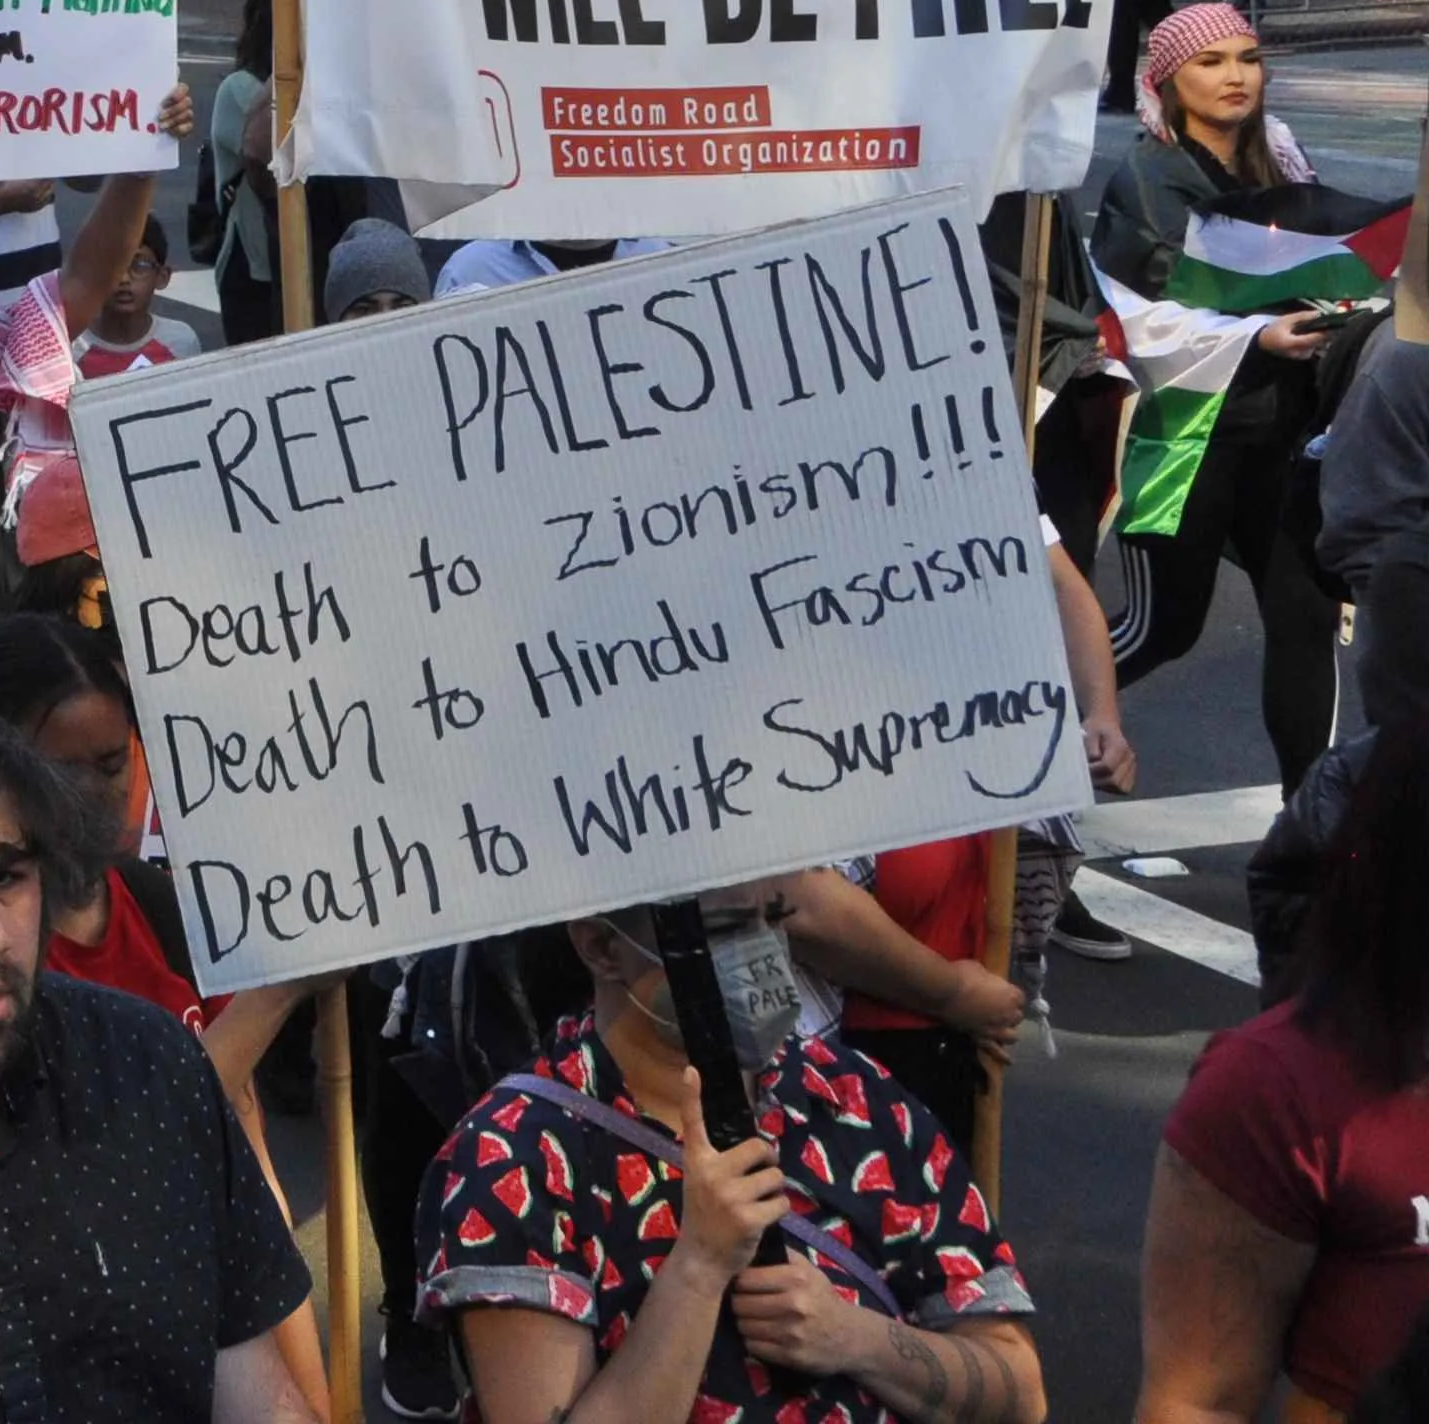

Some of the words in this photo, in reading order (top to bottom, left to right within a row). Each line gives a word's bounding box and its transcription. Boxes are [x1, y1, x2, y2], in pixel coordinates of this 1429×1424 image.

[553, 96, 667, 126] Freedom
[684, 94, 759, 125] Road
[560, 138, 687, 168] Socialist
[702, 132, 907, 172] Organization
[107, 374, 397, 559] FREE
[432, 215, 987, 482] PALESTINE!
[139, 561, 351, 674] Death
[408, 536, 482, 613] to
[163, 675, 386, 819] Death
[411, 657, 484, 740] to
[515, 600, 729, 720] Hindu
[750, 529, 1028, 649] Fascism
[188, 817, 443, 964] Death
[458, 801, 529, 877] to
[552, 733, 753, 860] White
[762, 675, 1069, 801] Supremacy
